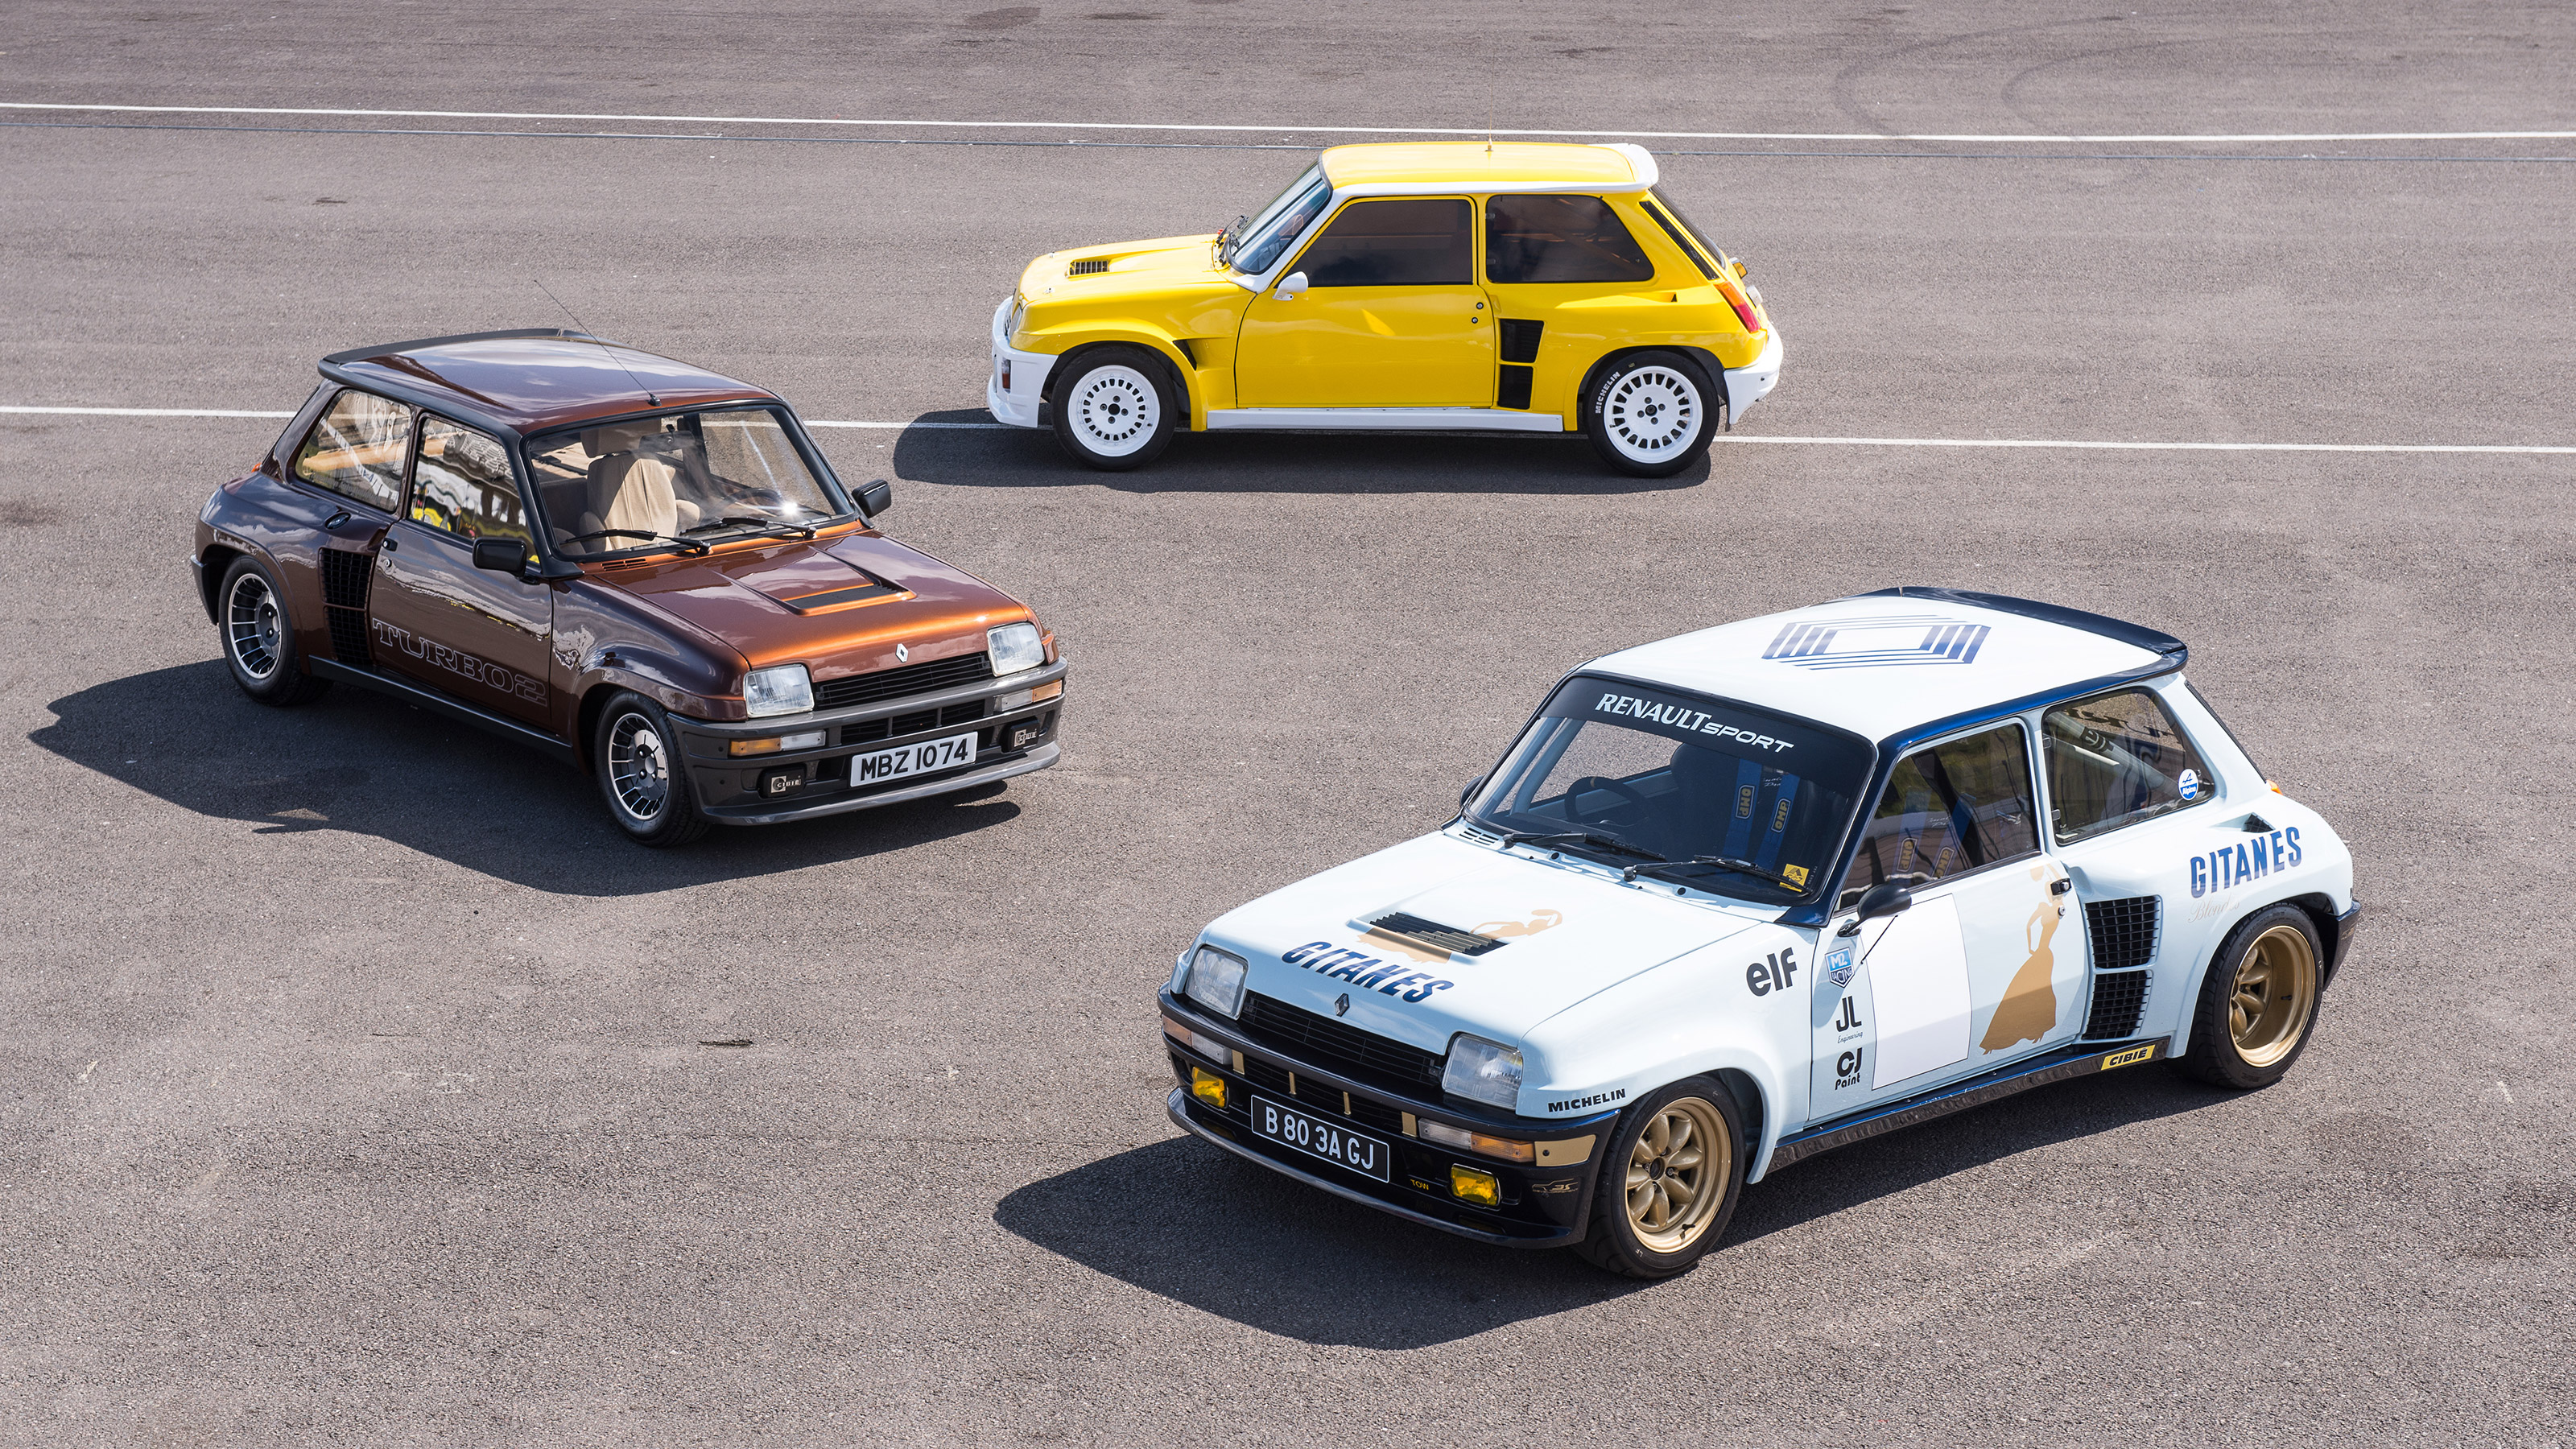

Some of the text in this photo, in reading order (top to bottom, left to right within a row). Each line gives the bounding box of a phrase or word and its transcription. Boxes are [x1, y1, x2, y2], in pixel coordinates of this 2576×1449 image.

[1595, 371, 1621, 414] MICHELIN
[1595, 693, 1794, 753] RENAULT SPORT
[860, 738, 968, 782] MBZ 1074
[1740, 787, 1752, 816] OMP
[1774, 800, 1788, 830] OMP
[1900, 840, 1913, 869] OMP
[2190, 827, 2302, 898] GITANES
[1282, 941, 1455, 1003] GITANES
[1746, 947, 1798, 997] elf
[1830, 952, 1848, 968] M2
[1831, 967, 1852, 983] RACING
[1835, 995, 1862, 1032] JL
[1837, 1030, 1864, 1044] Engineering
[1836, 1047, 1863, 1077] CJ
[1835, 1072, 1860, 1090] Paint
[1548, 1088, 1626, 1113] MICHELIN
[1265, 1106, 1374, 1170] B 80 3A GJ
[1410, 1179, 1430, 1191] TOW
